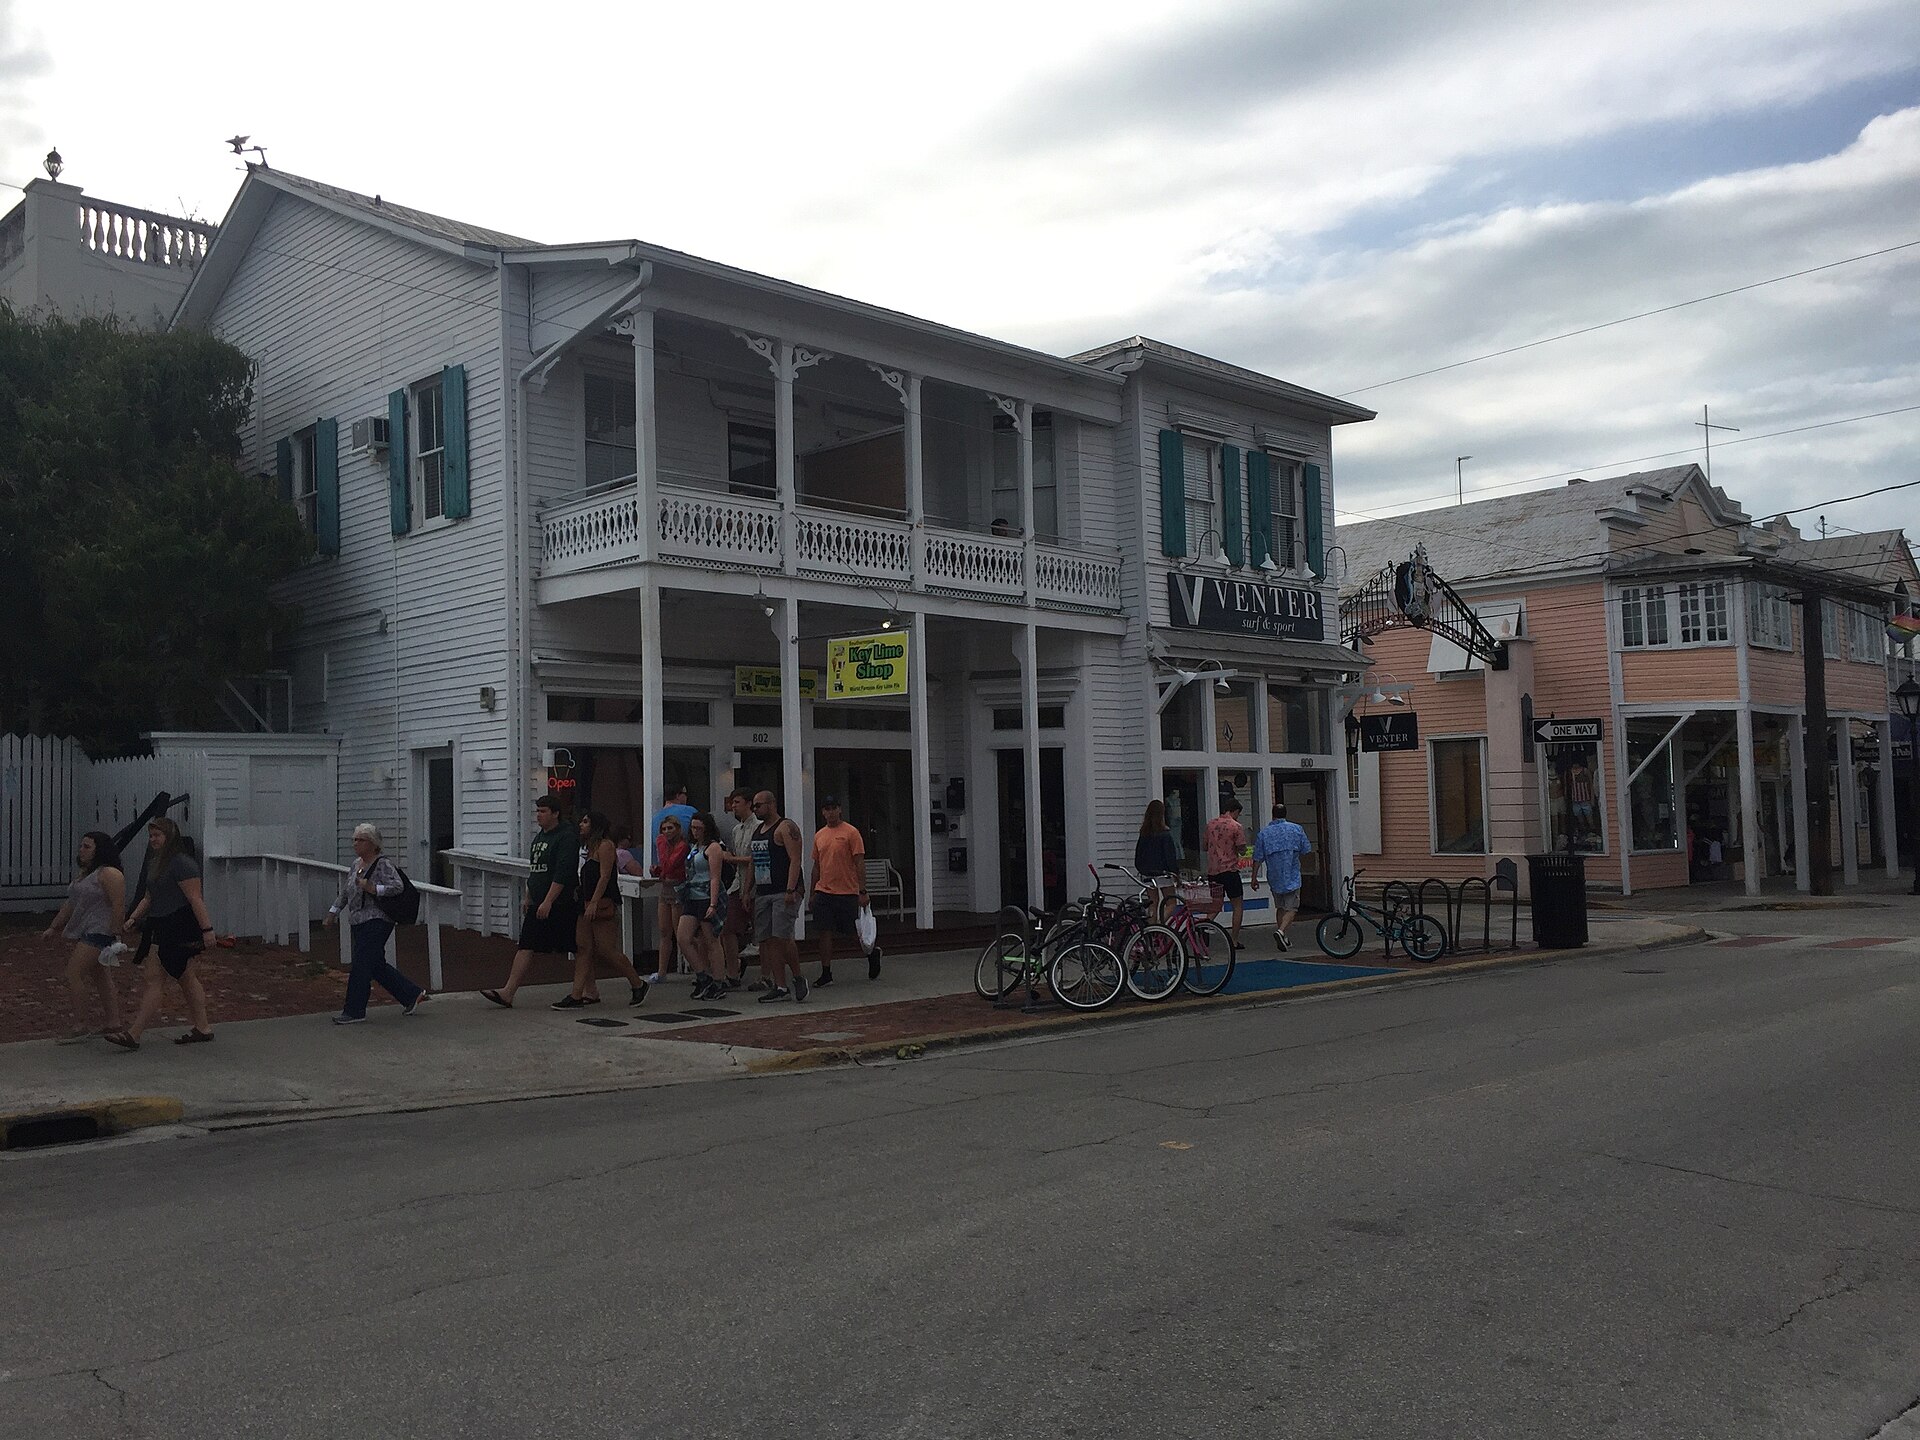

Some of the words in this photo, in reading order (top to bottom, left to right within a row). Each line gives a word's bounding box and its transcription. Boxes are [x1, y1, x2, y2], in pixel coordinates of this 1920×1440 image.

[1213, 579, 1319, 620] VENTER
[1241, 615, 1261, 633] surf
[1262, 618, 1271, 631] &
[1273, 621, 1296, 636] sport
[849, 646, 873, 664] Key
[873, 643, 904, 661] Lime
[856, 662, 894, 680] Shop
[752, 732, 769, 743] 802
[1553, 726, 1572, 736] ONE
[1574, 724, 1595, 735] WAY
[1369, 733, 1409, 743] VENTER
[1300, 757, 1314, 768] 800
[547, 777, 576, 792] Open
